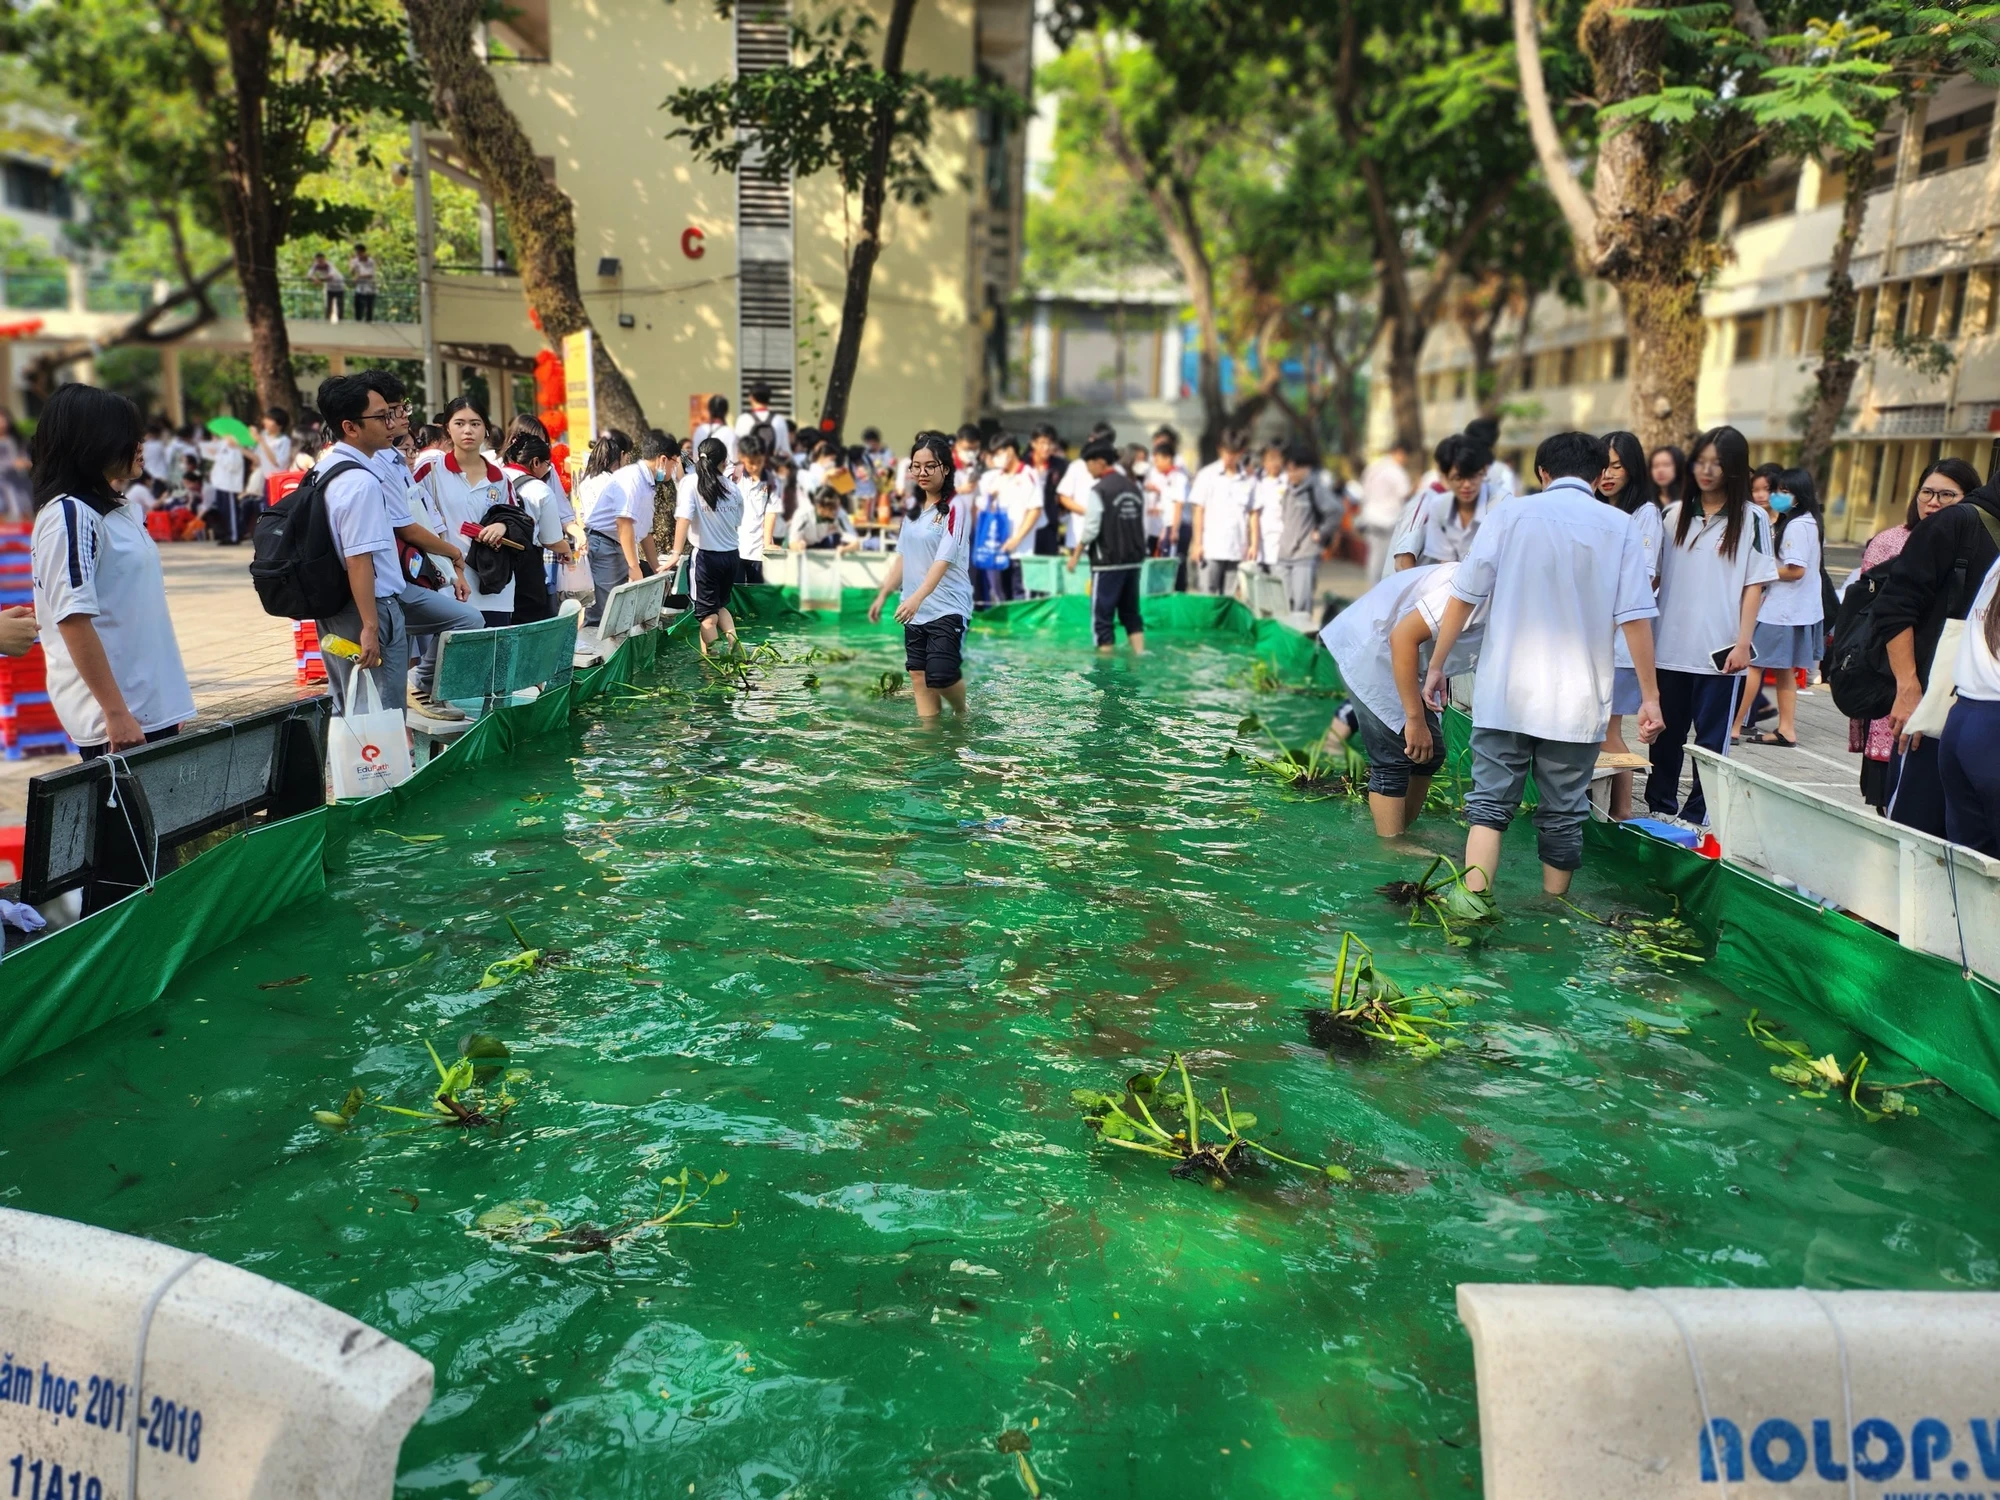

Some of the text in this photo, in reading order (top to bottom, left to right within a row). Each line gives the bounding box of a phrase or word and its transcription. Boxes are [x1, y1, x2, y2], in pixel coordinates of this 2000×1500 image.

[680, 226, 705, 260] C
[357, 763, 390, 774] EduPath
[38, 1361, 79, 1426] học
[85, 1375, 202, 1464] 201-2018
